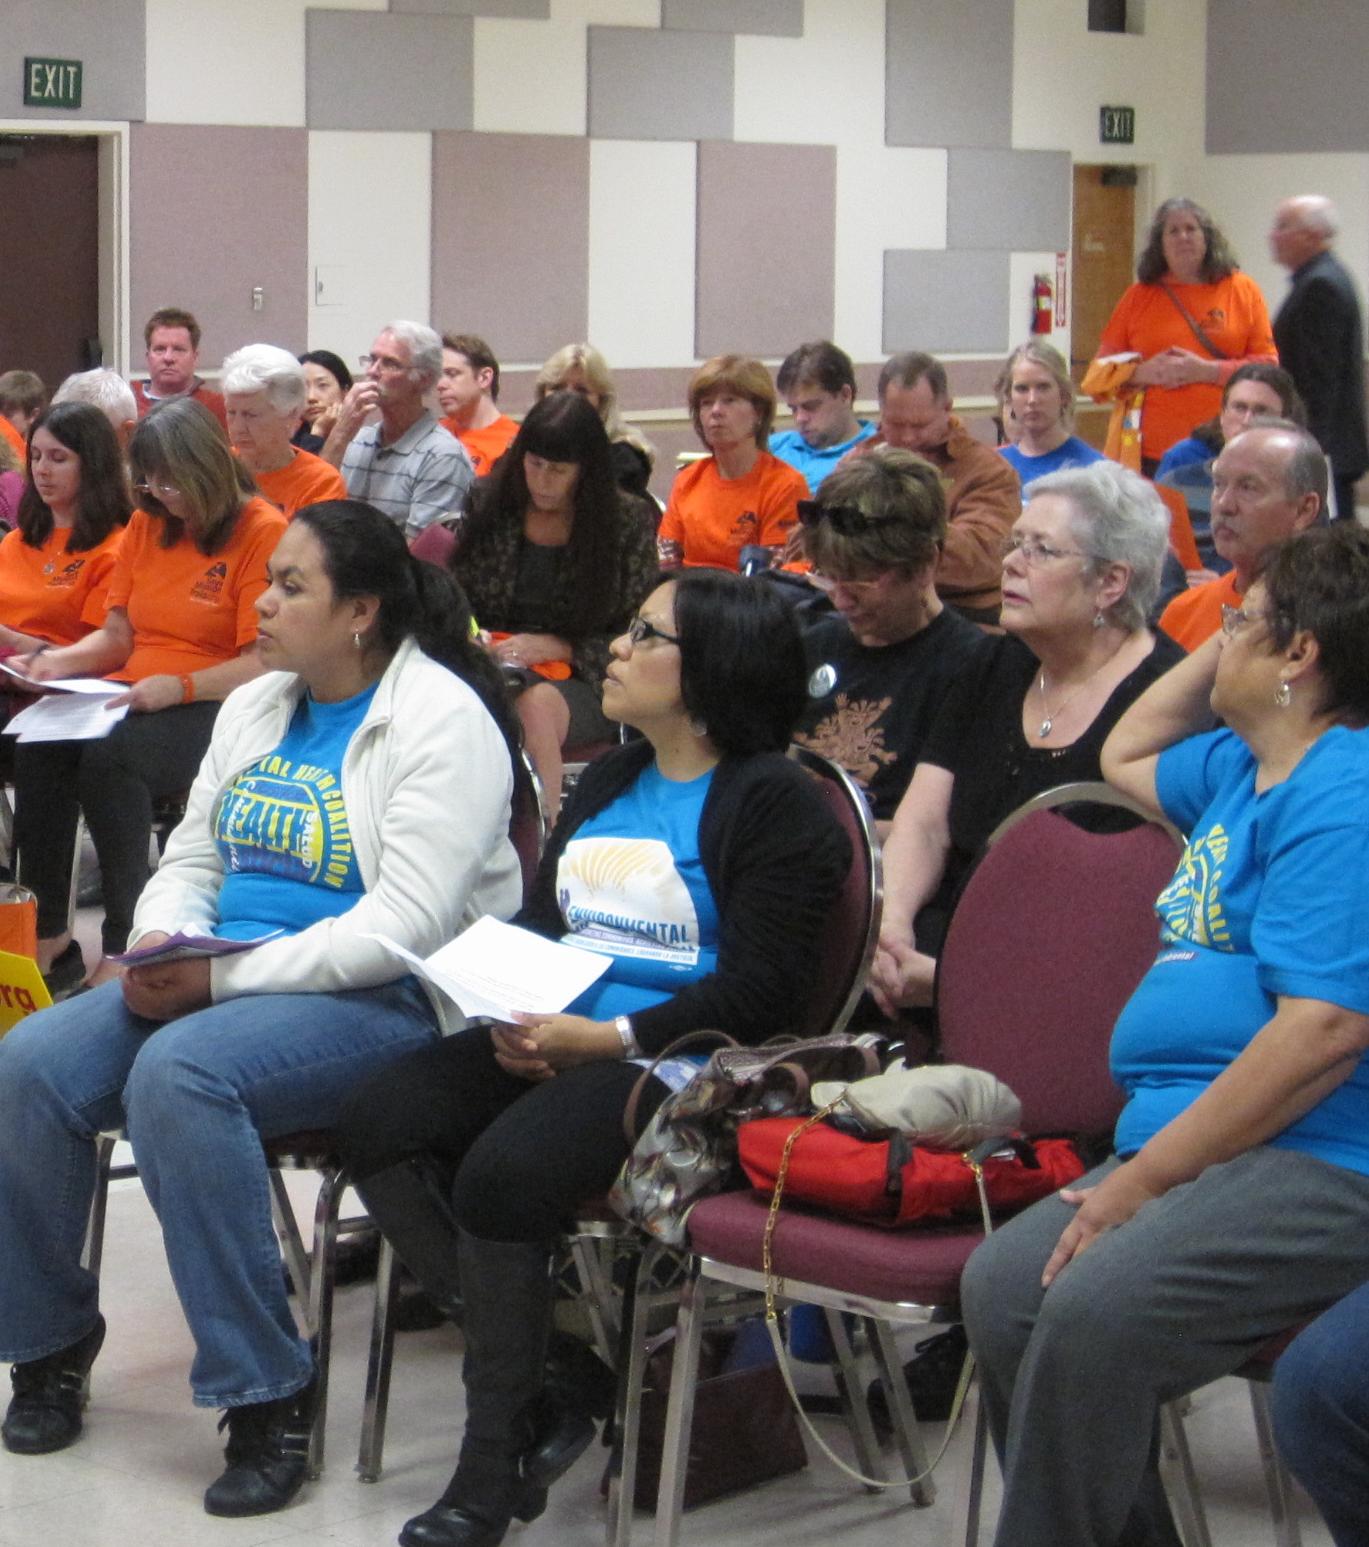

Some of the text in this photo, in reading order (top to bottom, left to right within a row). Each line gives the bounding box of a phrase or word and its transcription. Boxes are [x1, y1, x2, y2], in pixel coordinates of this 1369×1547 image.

[31, 63, 78, 99] EXIT
[1105, 111, 1132, 138] EXIT
[301, 811, 319, 869] SALUD
[322, 790, 352, 888] COALITION
